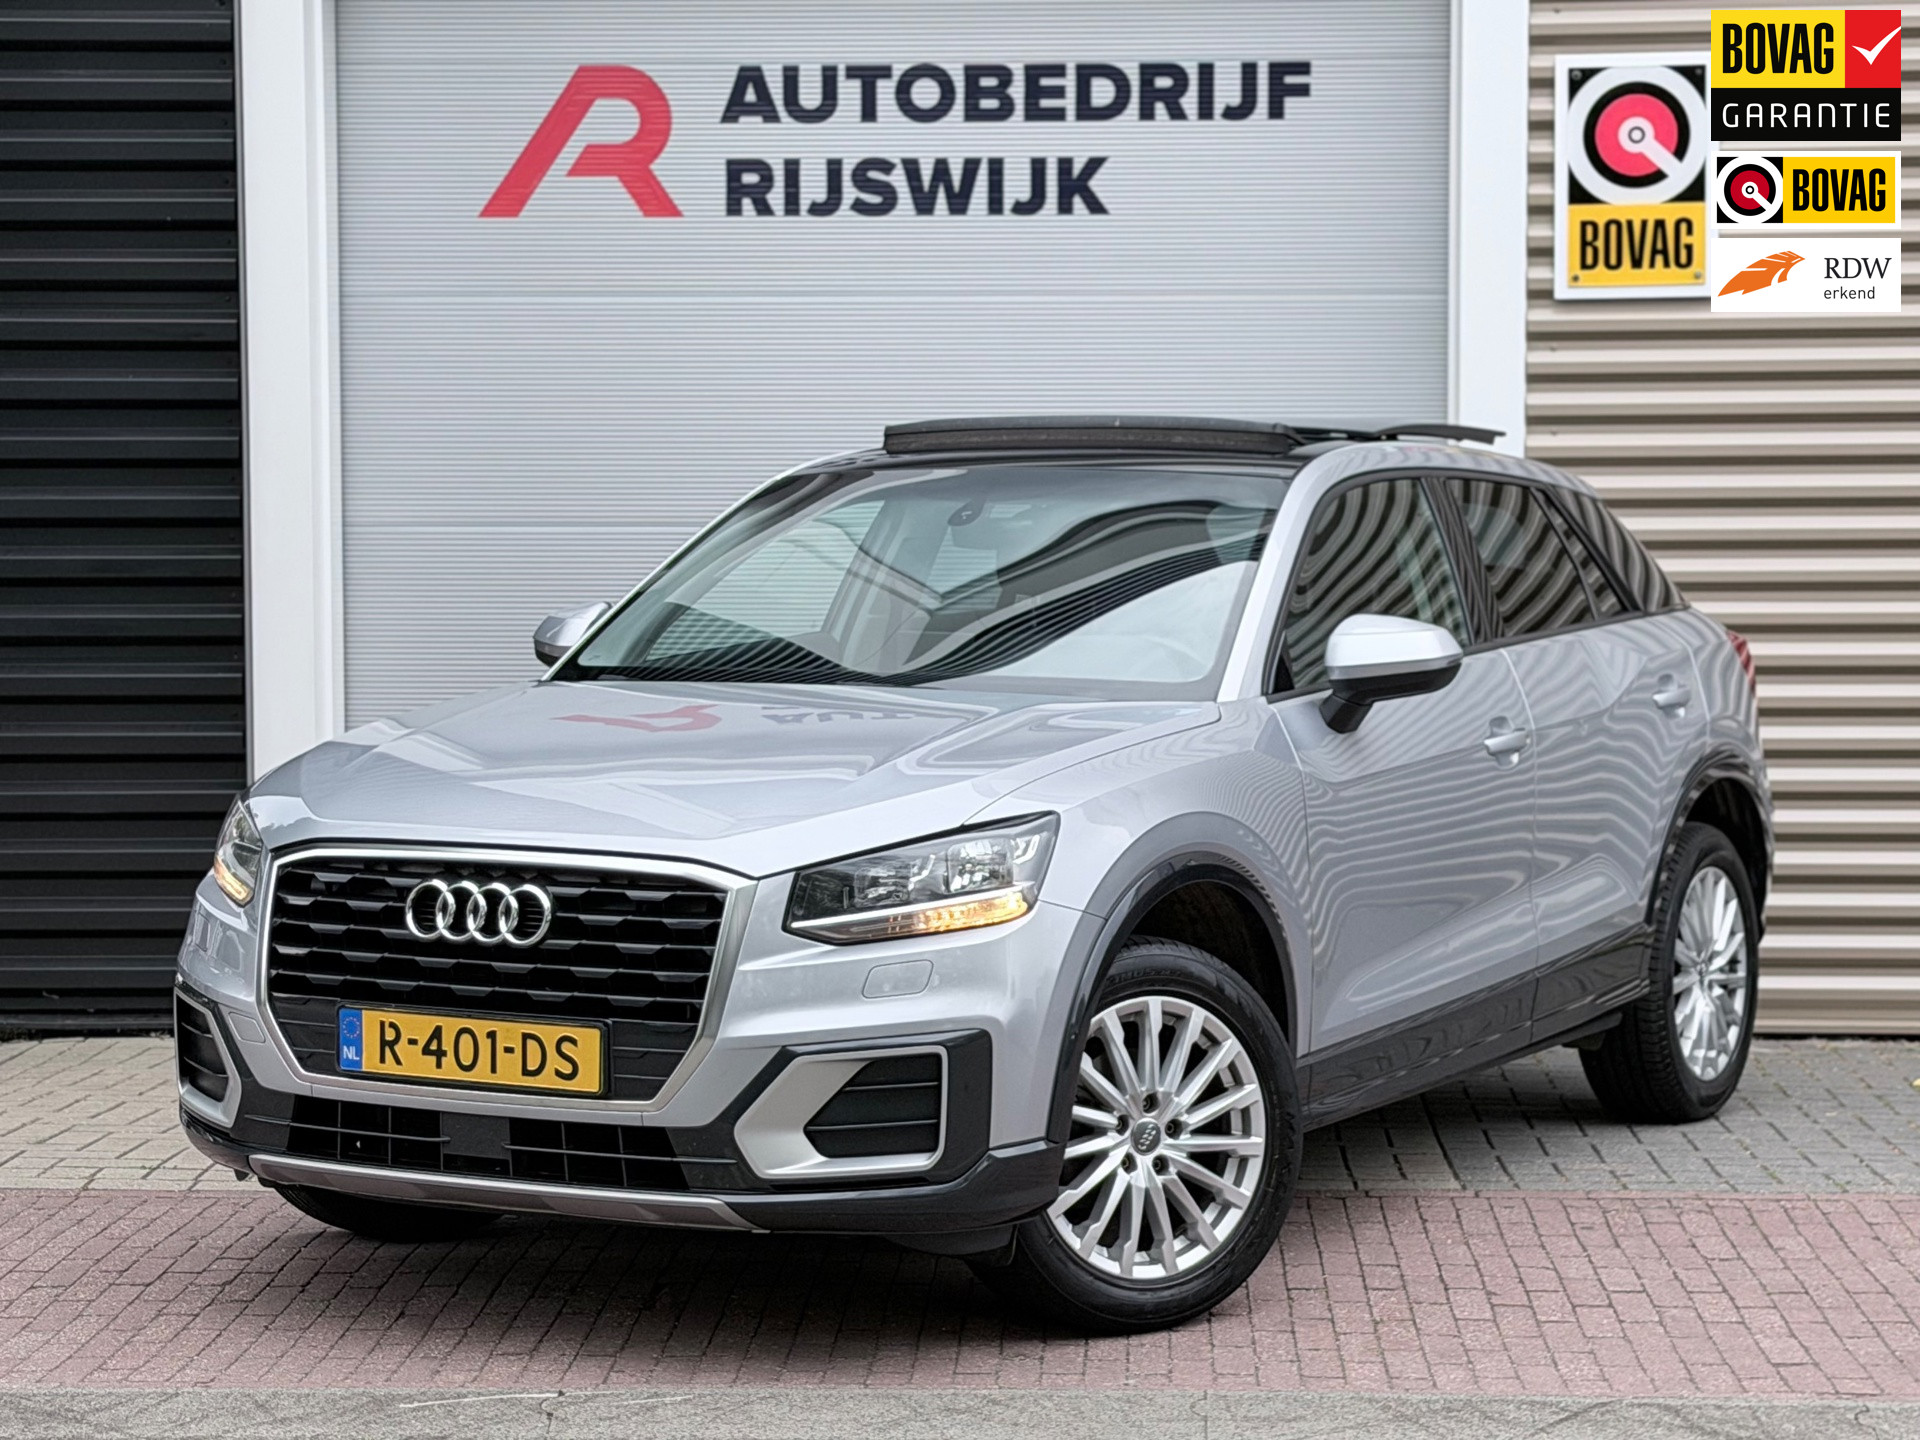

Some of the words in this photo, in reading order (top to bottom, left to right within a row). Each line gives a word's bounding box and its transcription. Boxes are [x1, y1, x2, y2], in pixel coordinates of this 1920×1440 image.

[720, 61, 1312, 124] AUTOBEDRIJF
[725, 156, 1110, 217] RIJSWIJK
[1579, 217, 1694, 271] BOVAG
[342, 1045, 360, 1061] NL
[379, 1019, 579, 1081] R-401-DS
